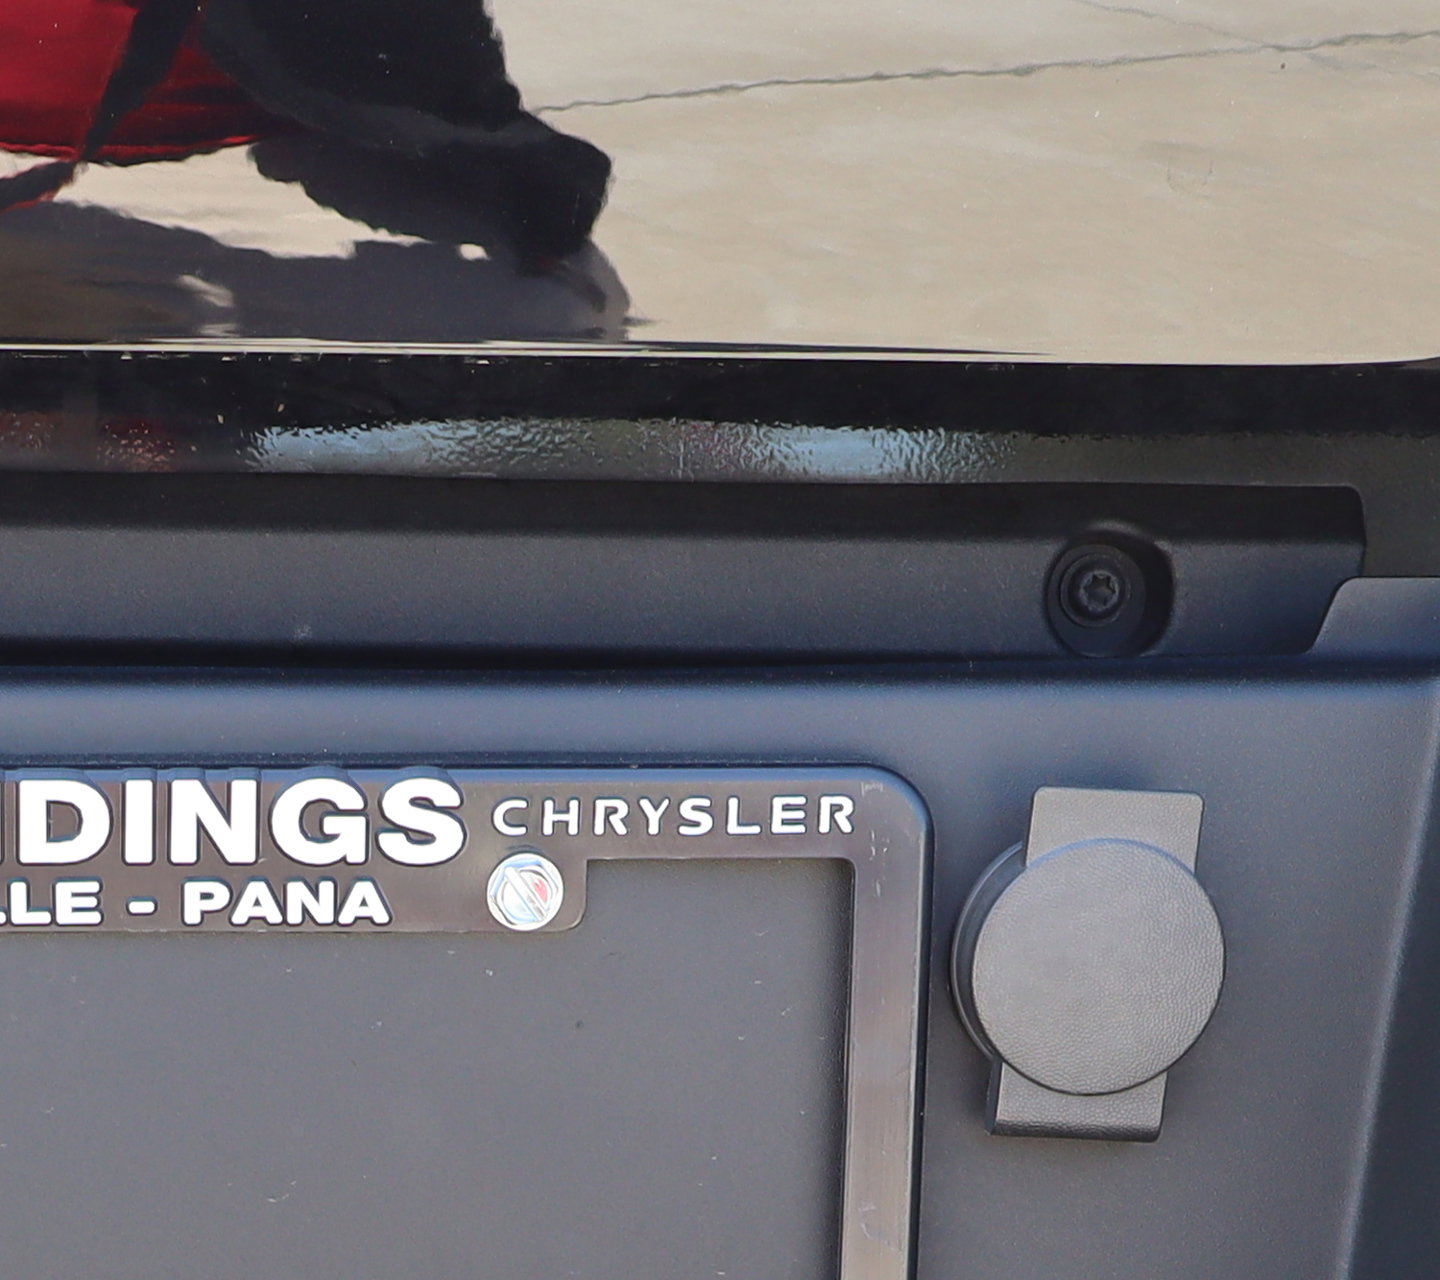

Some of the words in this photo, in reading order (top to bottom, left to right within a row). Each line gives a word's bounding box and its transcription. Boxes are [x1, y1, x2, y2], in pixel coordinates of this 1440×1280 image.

[493, 796, 853, 836] CHRYSLER
[128, 900, 155, 915] -
[184, 881, 390, 925] PANA
